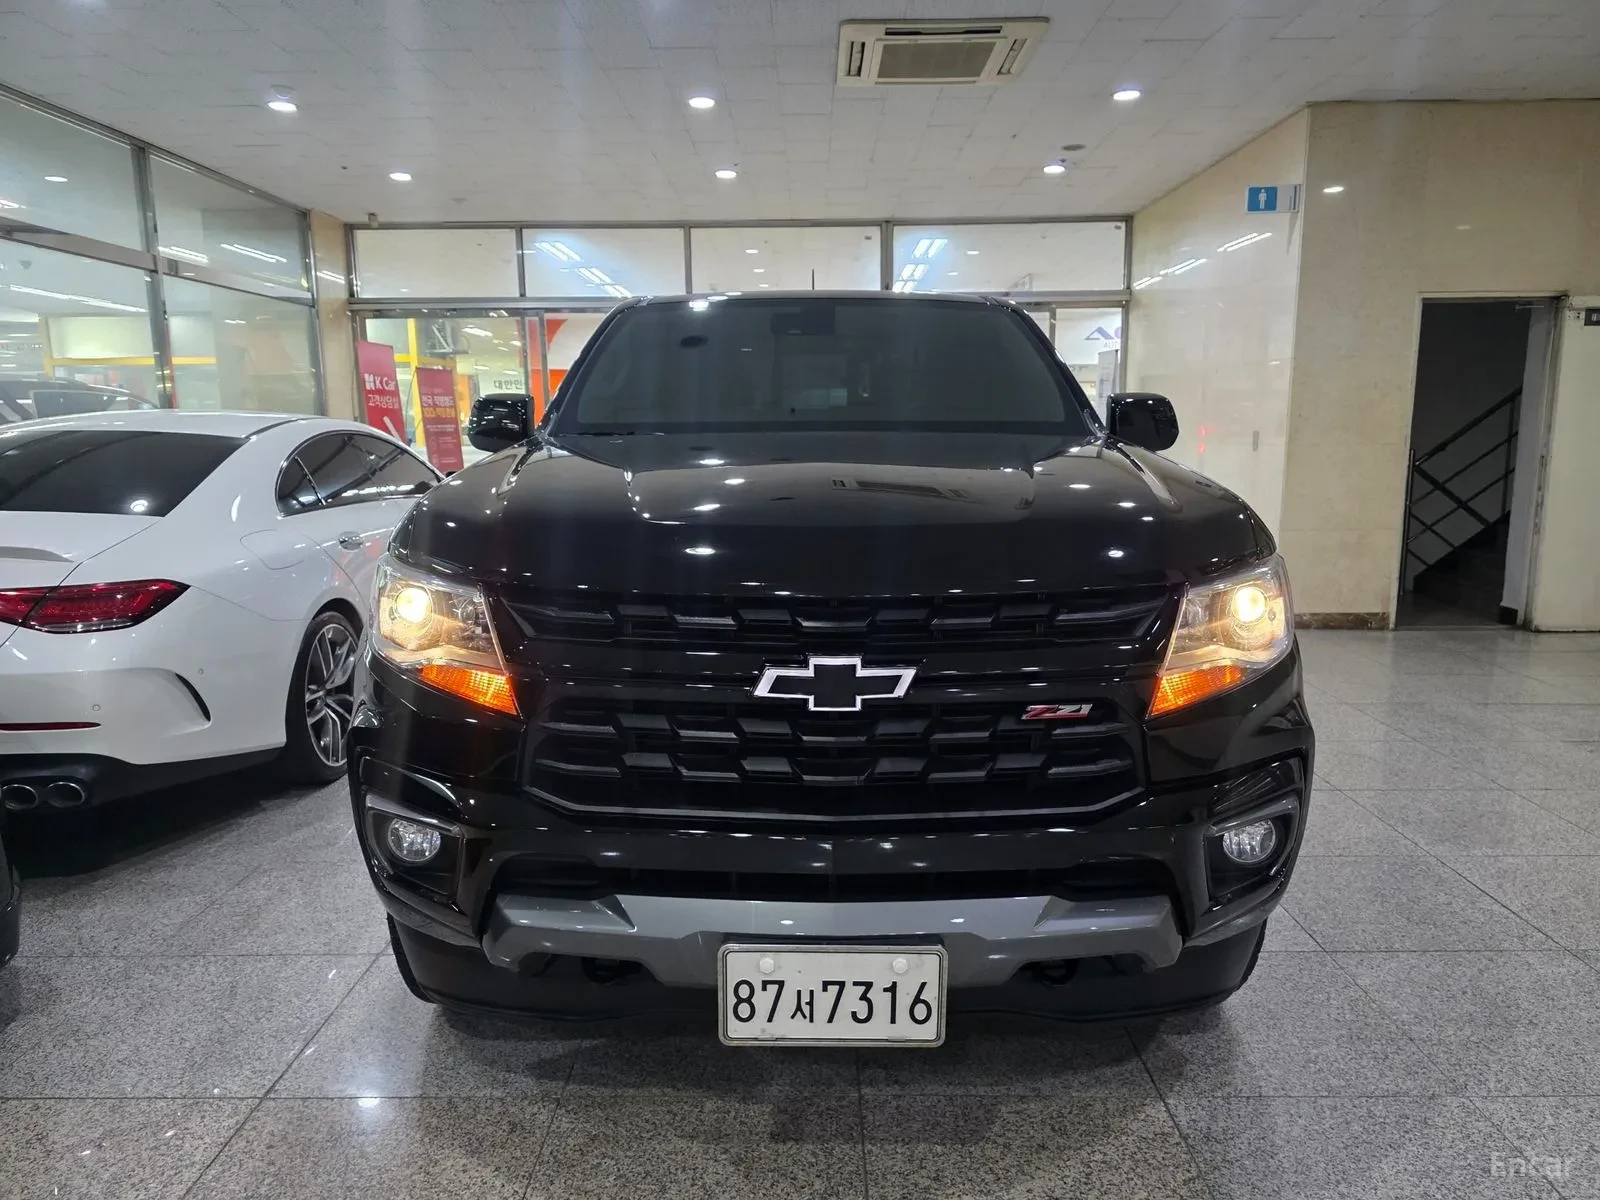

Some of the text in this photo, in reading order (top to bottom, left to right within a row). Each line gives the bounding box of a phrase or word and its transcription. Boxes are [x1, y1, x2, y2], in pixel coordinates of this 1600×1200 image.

[375, 376, 396, 391] K Car
[1021, 704, 1093, 720] Z71
[732, 979, 933, 1025] 87서7316
